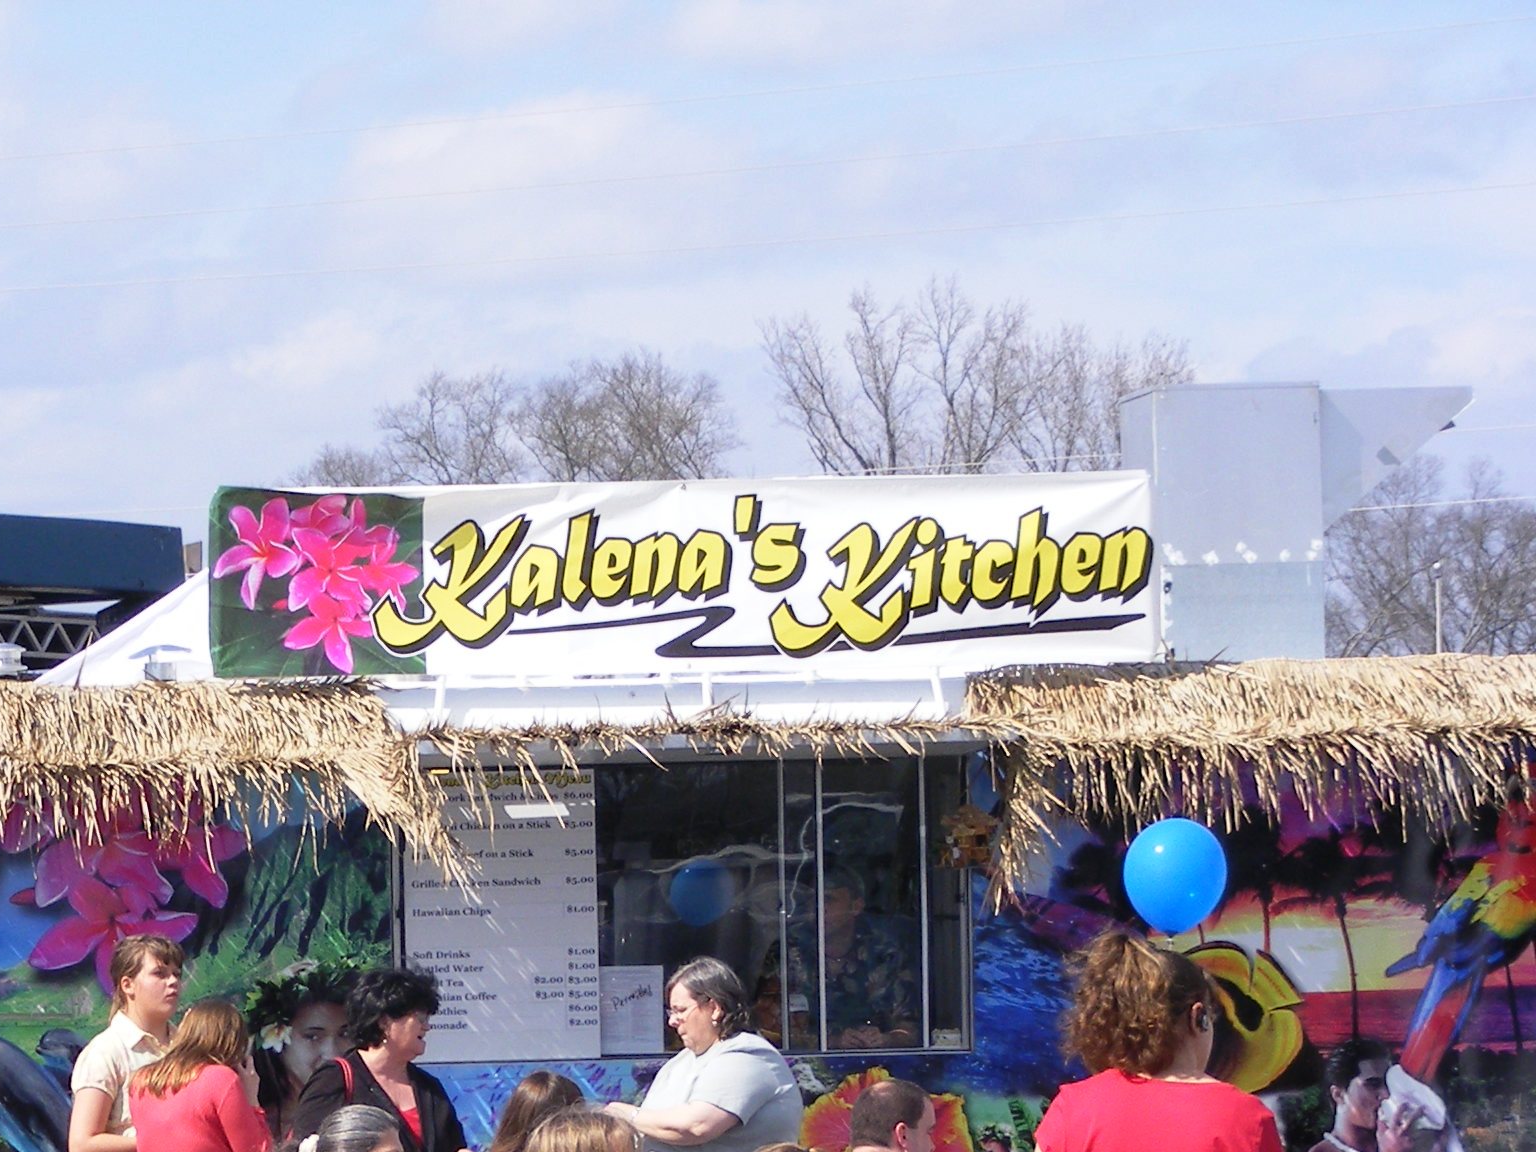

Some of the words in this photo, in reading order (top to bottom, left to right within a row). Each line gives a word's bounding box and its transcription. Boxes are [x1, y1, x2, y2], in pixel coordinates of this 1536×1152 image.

[373, 494, 807, 654] Kalena's
[769, 505, 1153, 658] Kitchen
[564, 791, 593, 800] $6.00
[526, 820, 552, 830] Stick
[508, 848, 534, 859] Stick
[564, 848, 594, 858] $5.00
[491, 877, 541, 888] Sandwich
[565, 876, 595, 885] $5.00
[412, 907, 461, 917] Hawaiian
[462, 907, 492, 918] Chips
[566, 905, 595, 914] $1.00
[413, 950, 433, 960] Soft
[435, 950, 471, 959] Drinks
[567, 947, 596, 956] $1.00
[452, 964, 484, 973] Water
[568, 962, 596, 971] $1.00
[446, 979, 464, 988] Tea
[534, 975, 564, 985] $2.00
[567, 975, 598, 985] $3.00
[464, 991, 498, 1002] Coffee
[535, 990, 565, 999] $3.00
[568, 989, 598, 999] $5.00
[568, 1003, 598, 1013] $6.00
[569, 1018, 598, 1027] $2.00
